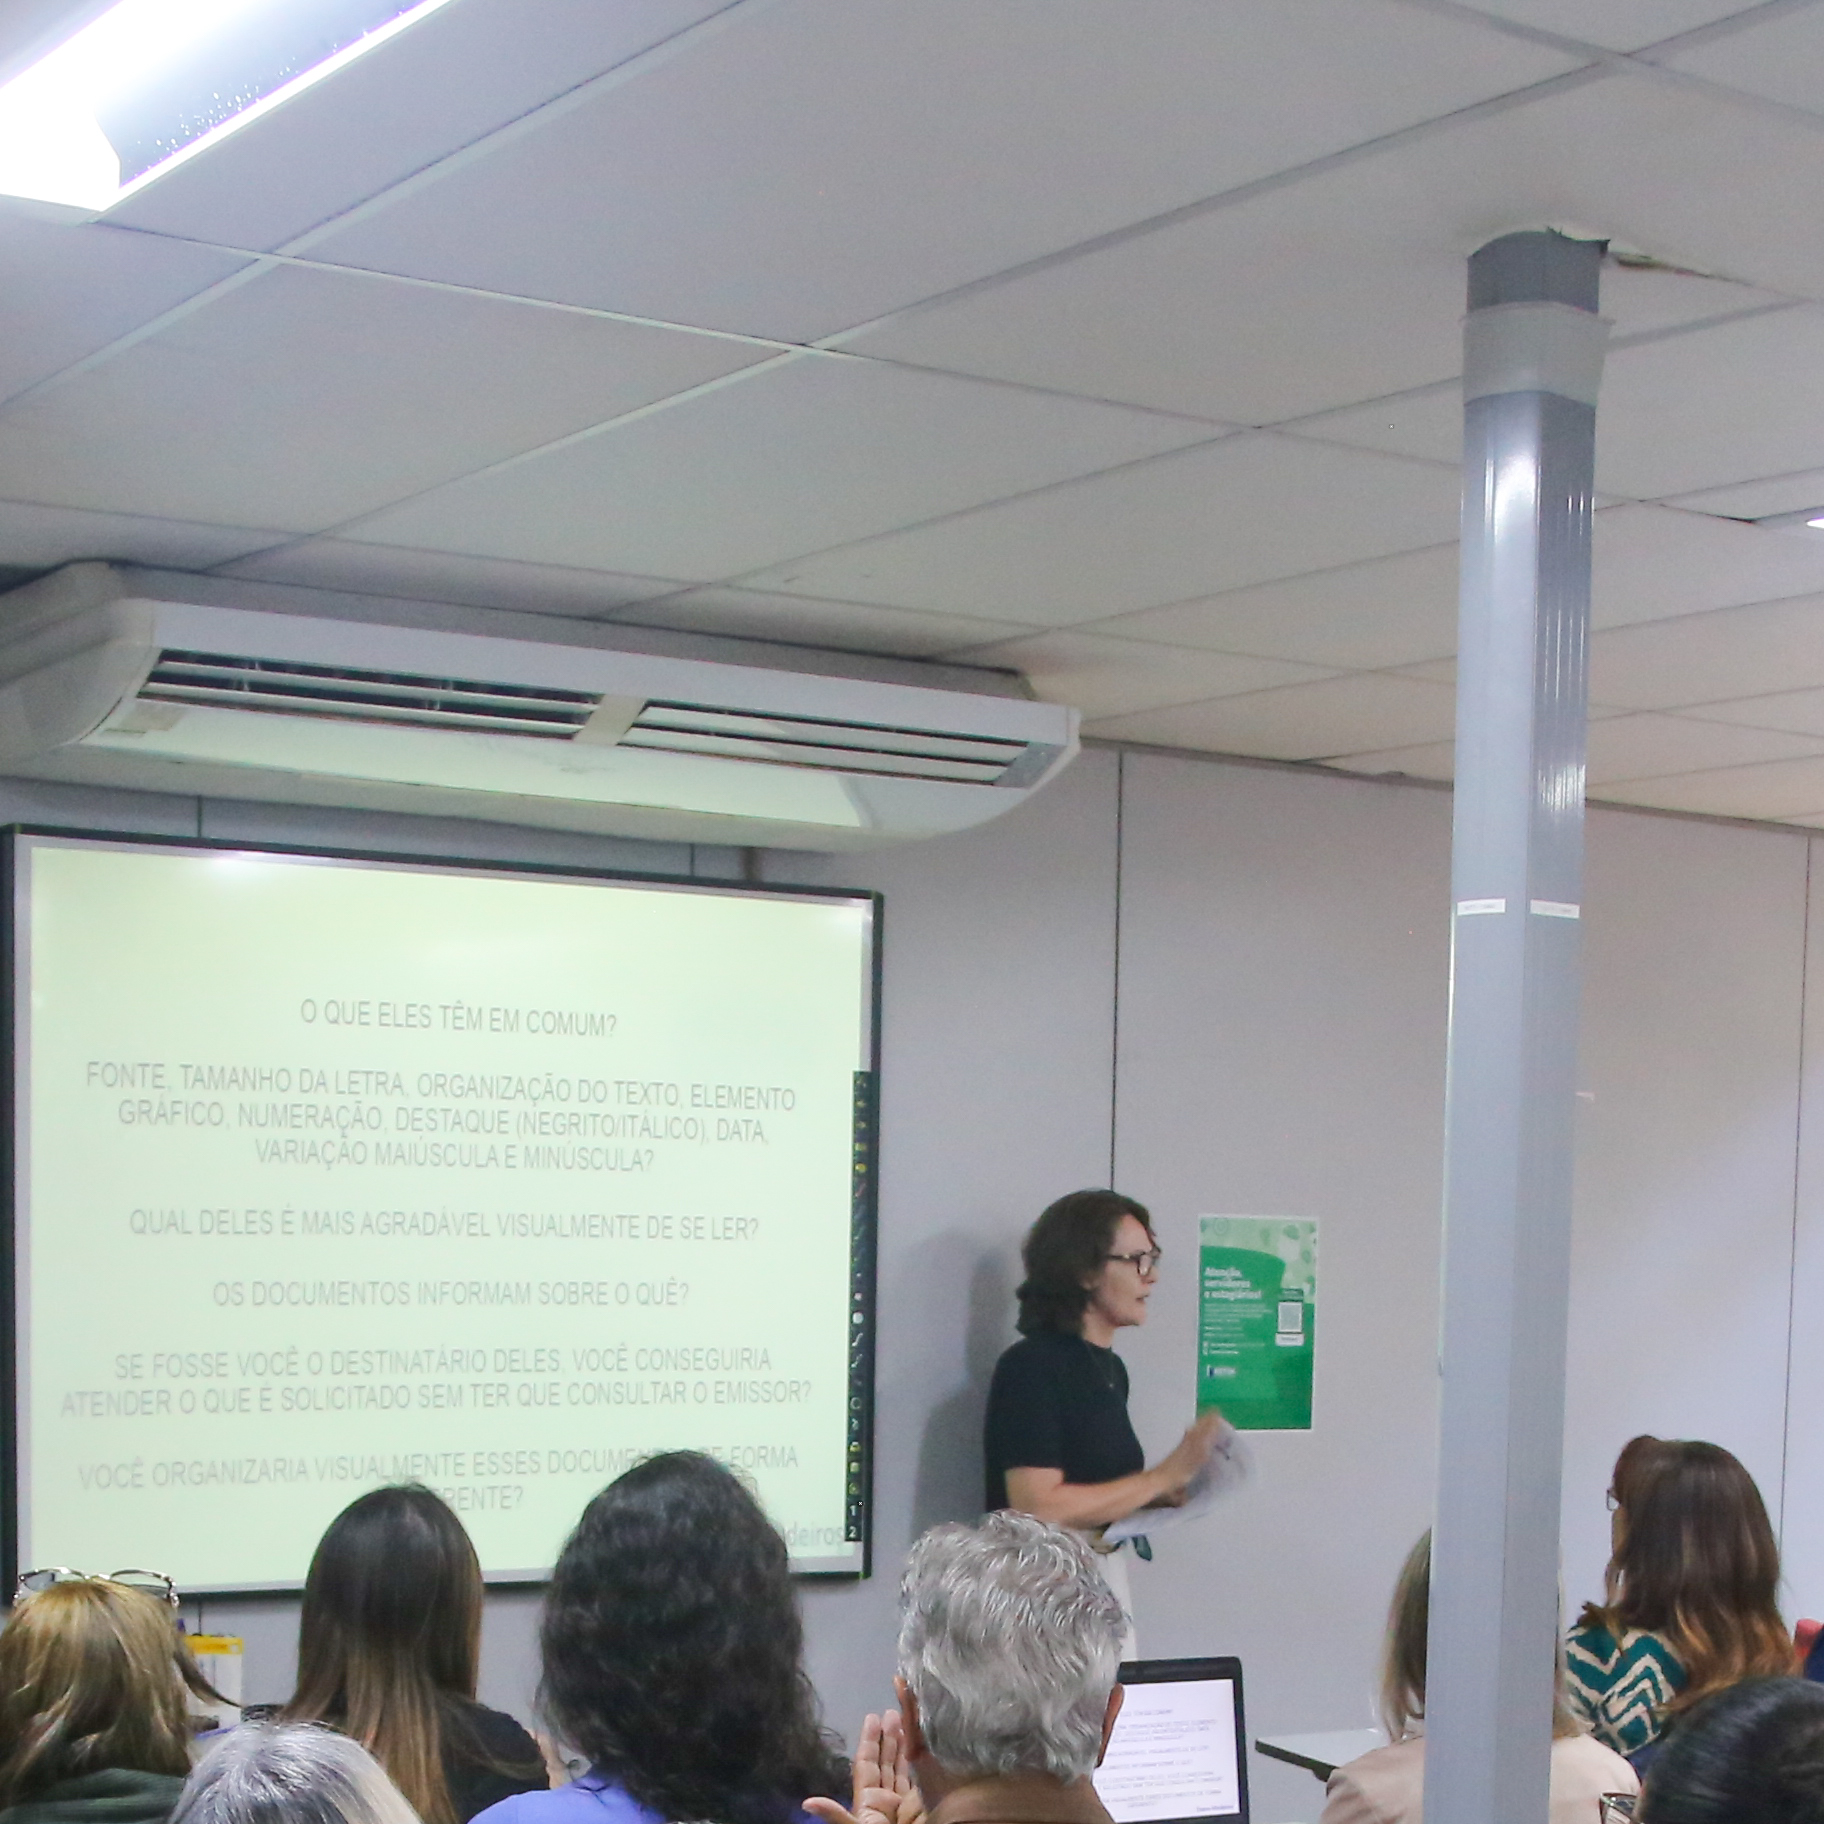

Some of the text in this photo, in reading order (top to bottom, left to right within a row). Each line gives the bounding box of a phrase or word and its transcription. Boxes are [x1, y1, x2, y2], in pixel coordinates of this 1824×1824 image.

[300, 999, 617, 1037] O QUE ELES TÊM EM COMUM?
[179, 1064, 291, 1093] TAMANHO
[299, 1068, 327, 1094] DA
[335, 1070, 410, 1098] LETRA,
[417, 1073, 571, 1107] ORGANIZAÇÃO
[578, 1079, 608, 1104] DO
[614, 1080, 684, 1110] TEXTO,
[690, 1083, 796, 1112] ELEMENTO
[395, 1107, 510, 1136] DESTAQUE
[255, 1133, 655, 1172] VARIAÇÃO MAIÚSCULA E MINÚSCULA?
[129, 1203, 760, 1241] QUAL DELES É MAIS AGRADÁVEL VISUALMENTE DE SE LER?
[212, 1275, 690, 1307] OS DOCUMENTOS INFORMAM SOBRE O QUÊ?
[114, 1353, 144, 1380] SE
[152, 1352, 229, 1379] FOSSE
[236, 1345, 299, 1377] VOCÊ
[306, 1351, 323, 1376] O
[330, 1343, 487, 1376] DESTINATÁRIO
[572, 1342, 629, 1373] VOCÊ
[634, 1347, 773, 1372] CONSEGUIRIA
[60, 1379, 812, 1418] ATENDER O QUE É SOLICITADO SEM TER QUE CONSULTAR O EMISSOR?
[77, 1456, 145, 1490] VOCÊ
[152, 1457, 310, 1487] ORGANIZARIA
[314, 1451, 466, 1483] VISUALMENTE
[472, 1449, 541, 1477] ESSES
[730, 1445, 799, 1468] FORMA
[849, 1505, 857, 1517] 1
[848, 1526, 857, 1538] 2
